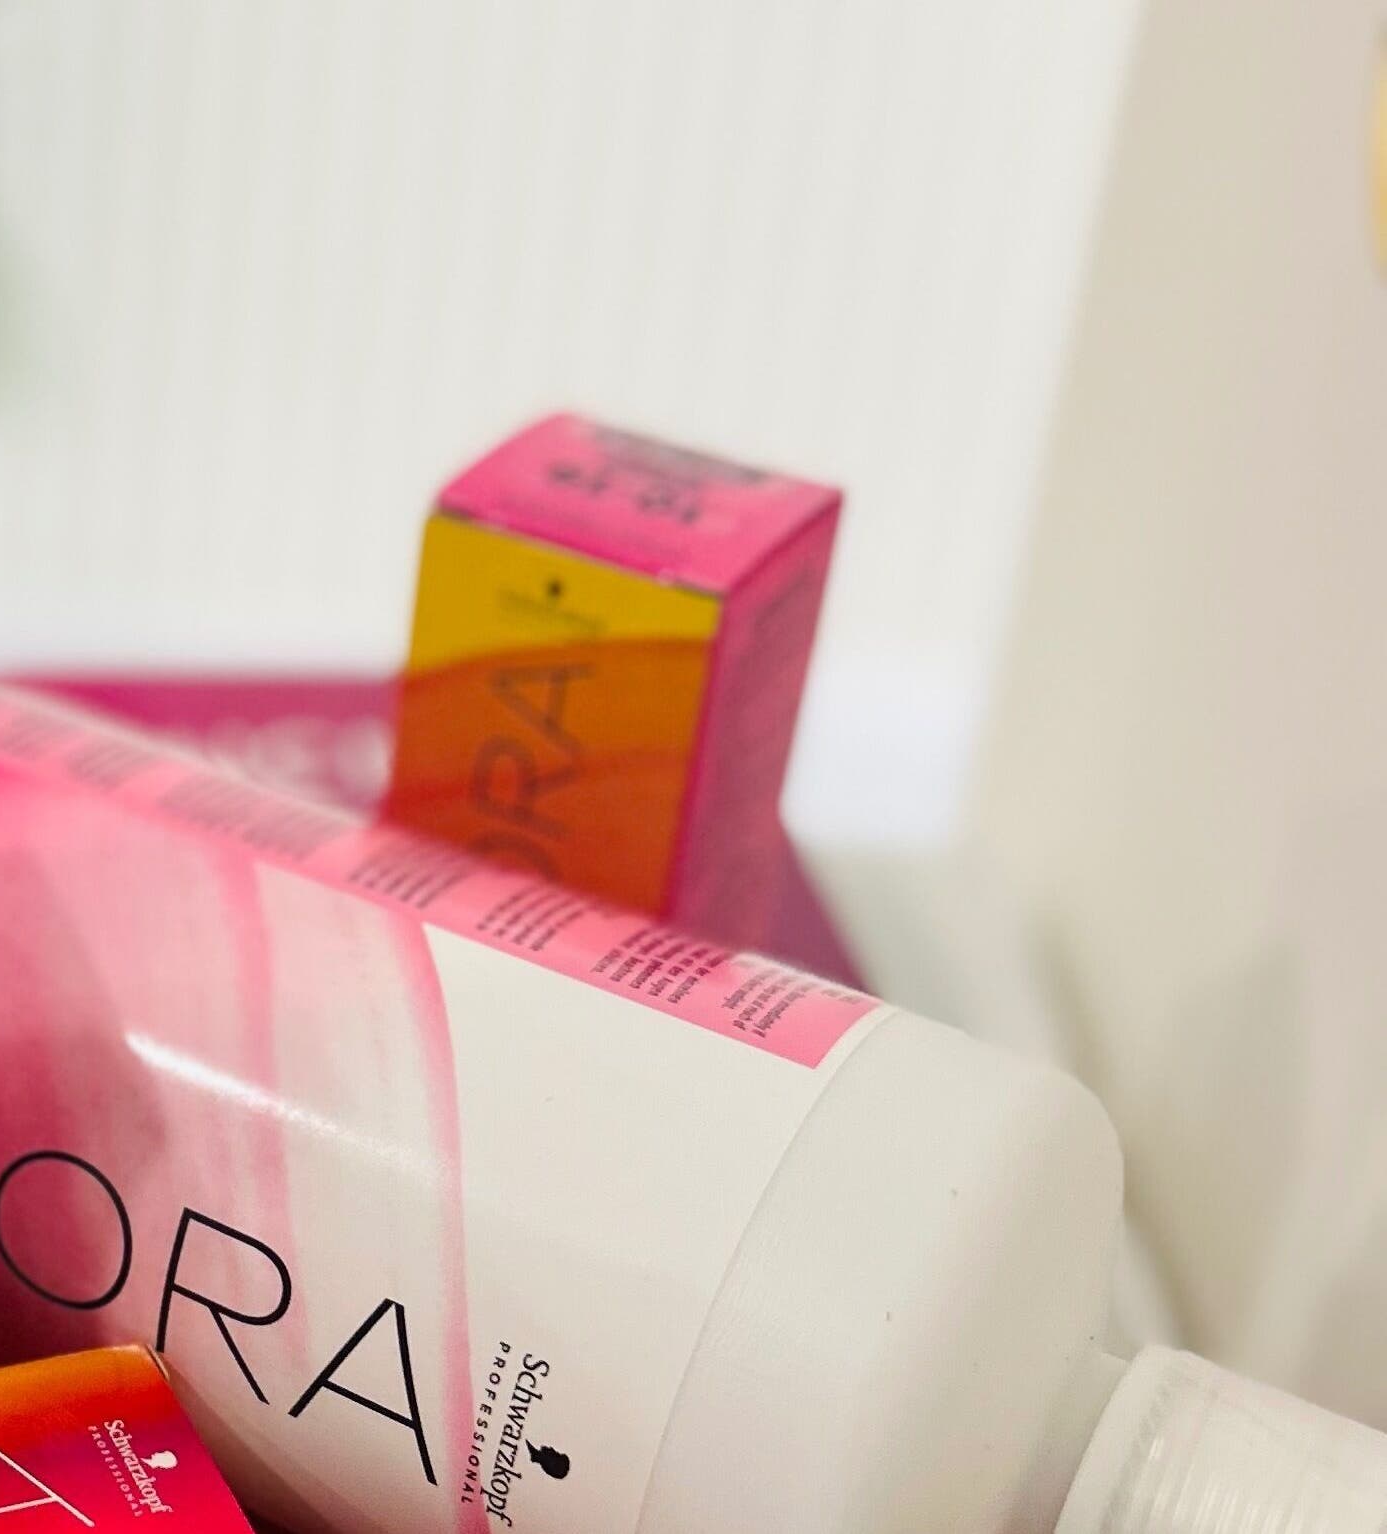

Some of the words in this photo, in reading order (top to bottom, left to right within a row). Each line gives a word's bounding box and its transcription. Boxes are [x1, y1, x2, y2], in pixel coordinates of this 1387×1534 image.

[103, 1419, 174, 1514] Schwarzkopf
[461, 1340, 512, 1504] PROFESSIONAL
[480, 1353, 550, 1528] Schwarzkopf
